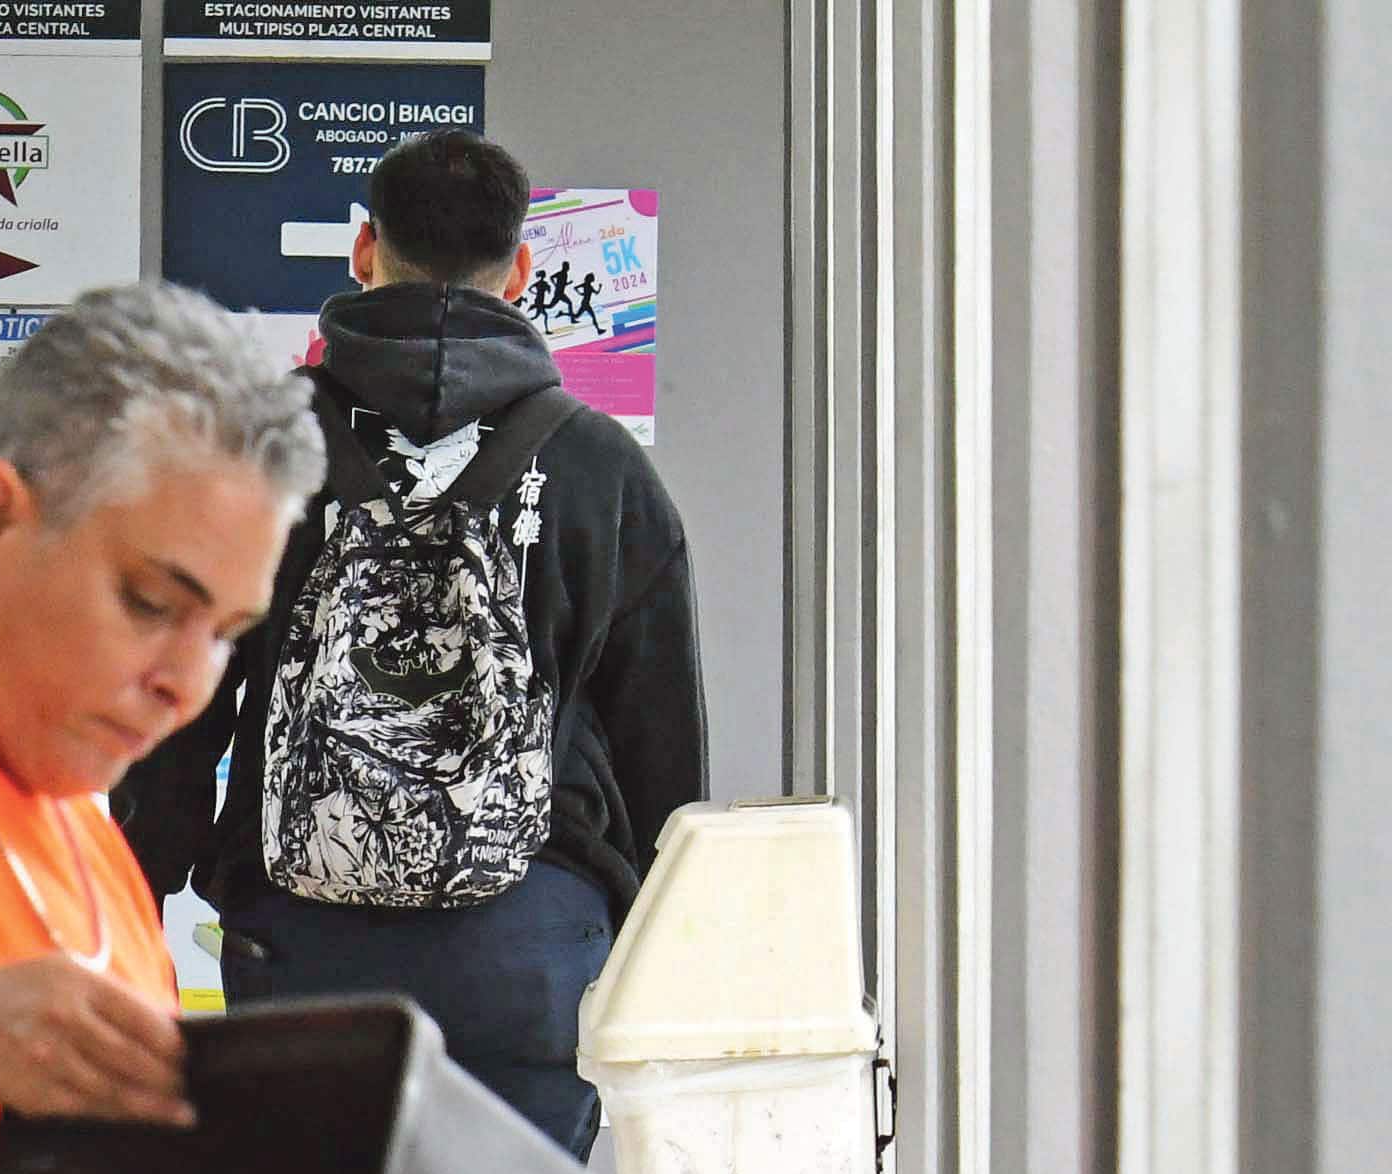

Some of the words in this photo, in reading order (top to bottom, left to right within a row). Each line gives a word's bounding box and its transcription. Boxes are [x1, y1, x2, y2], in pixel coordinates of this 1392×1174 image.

[15, 4, 105, 18] VISITANTES
[204, 3, 357, 19] ESTACIONAMIENTO
[360, 5, 451, 20] VISITANTES
[17, 22, 89, 36] CENTRAL
[219, 22, 305, 36] MULTIPISO
[309, 23, 359, 37] PLAZA
[363, 24, 435, 38] CENTRAL
[315, 130, 388, 143] ABOGADO
[16, 217, 58, 231] criolla
[602, 235, 642, 275] 5K
[613, 272, 648, 291] 2024
